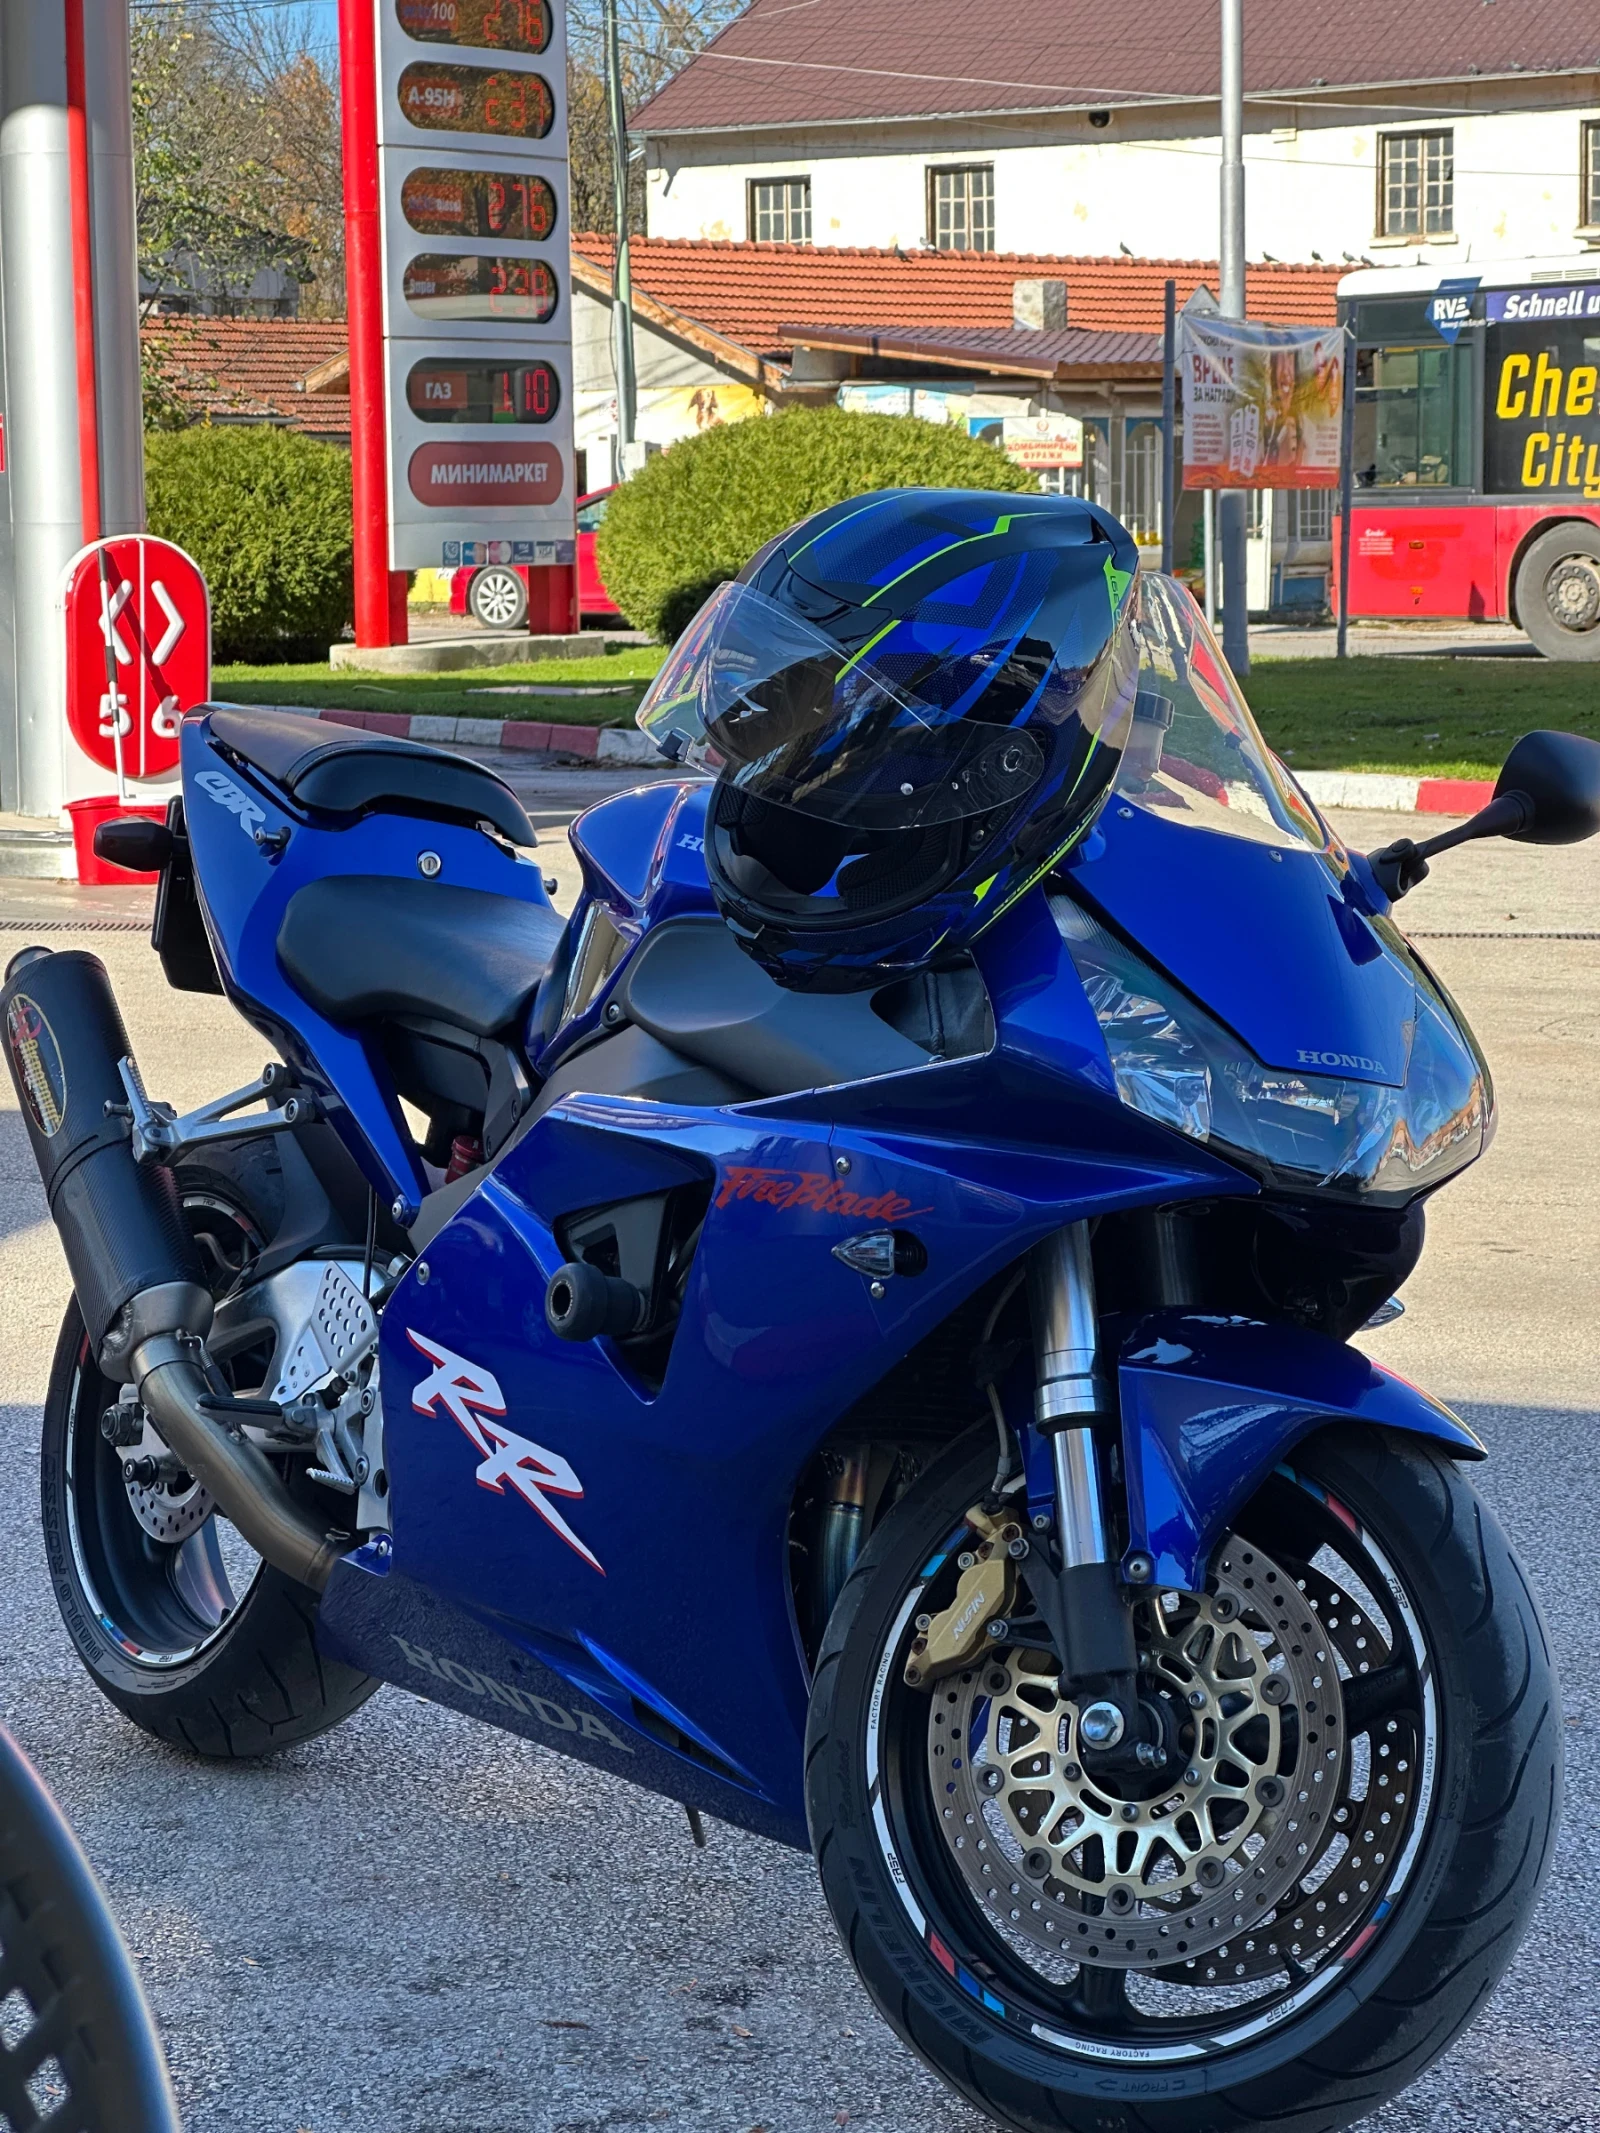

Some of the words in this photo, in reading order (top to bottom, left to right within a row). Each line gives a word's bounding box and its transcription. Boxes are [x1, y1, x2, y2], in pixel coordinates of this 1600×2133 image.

[1433, 296, 1470, 320] RVE
[1503, 290, 1584, 319] Schnell
[425, 382, 452, 399] ГАЗ
[1496, 353, 1598, 419] Che
[430, 462, 549, 484] МИНИМАРКЕТ
[1521, 432, 1600, 498] City
[98, 693, 133, 738] 5
[151, 695, 182, 738] 6
[1297, 1049, 1387, 1075] HONDA
[391, 1634, 634, 1754] HONDA
[870, 1689, 881, 1730] FACTORY
[876, 1652, 891, 1686] RACING
[1424, 1737, 1433, 1780] FACTORY
[1074, 2041, 1107, 2055] RACING
[1110, 2049, 1150, 2058] FACTORY
